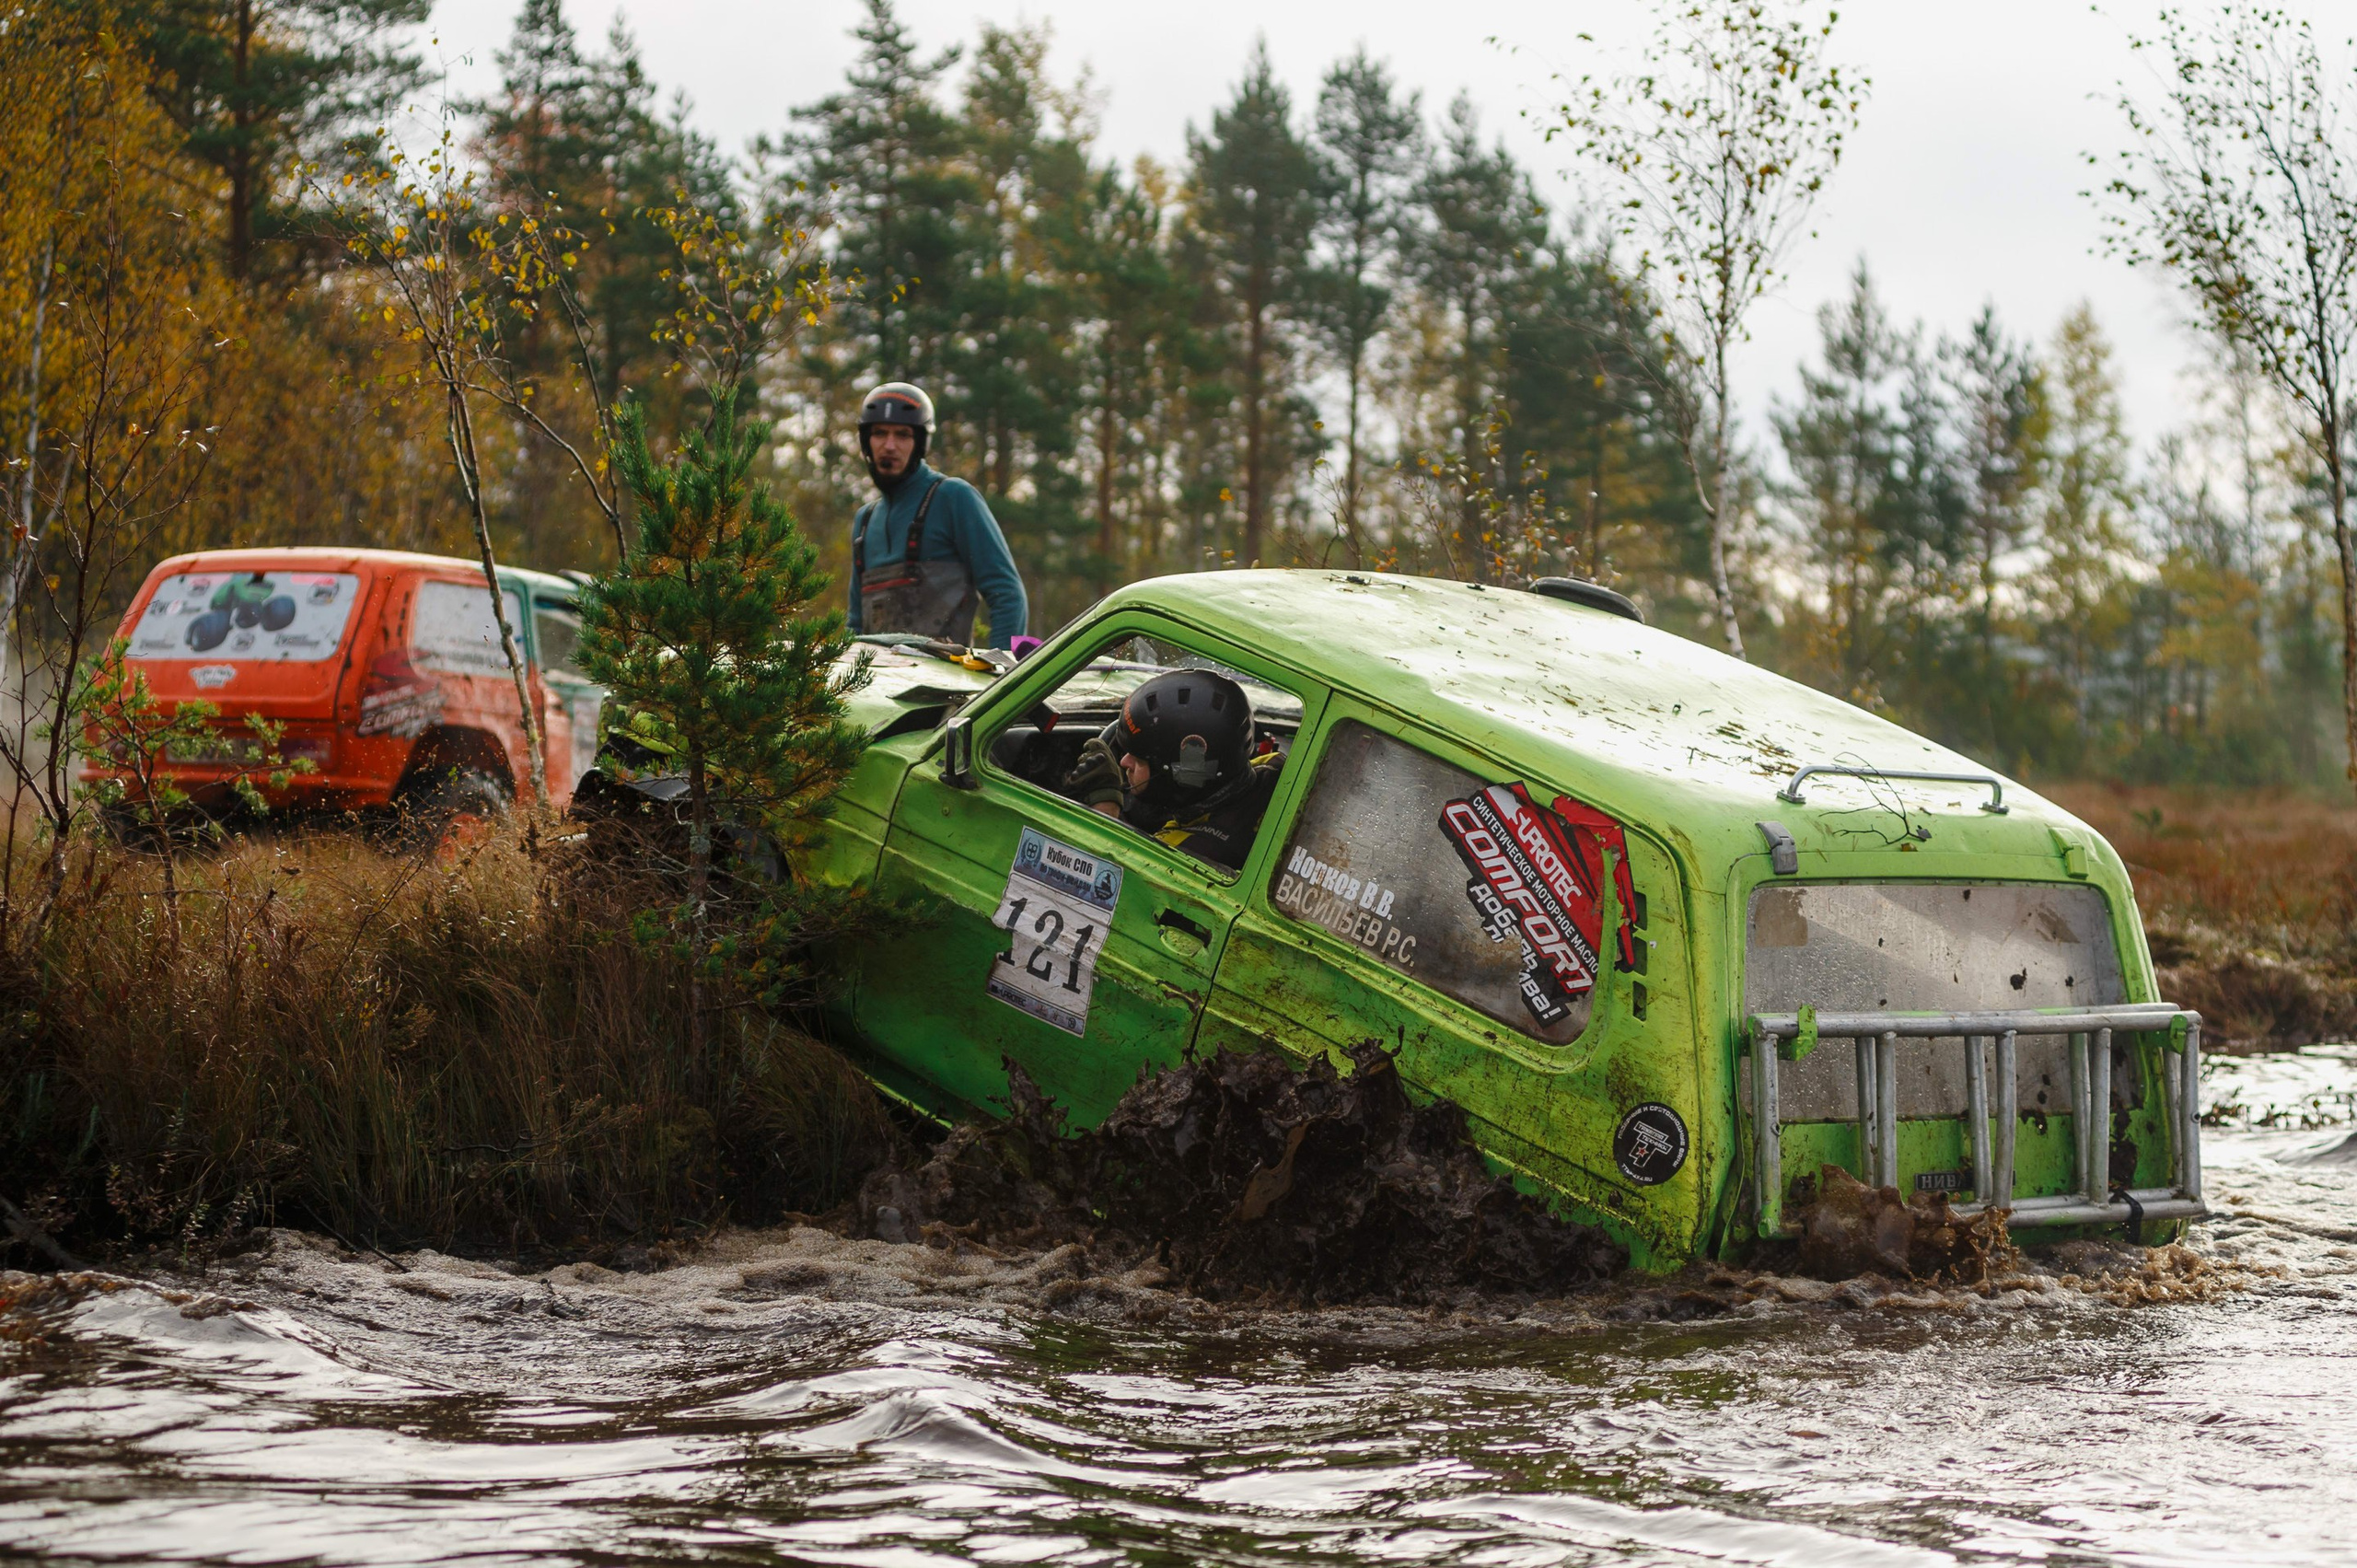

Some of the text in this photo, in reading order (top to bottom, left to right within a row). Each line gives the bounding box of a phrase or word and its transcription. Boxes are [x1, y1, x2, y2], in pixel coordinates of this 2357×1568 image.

[1047, 846, 1093, 877] Кубок СПб
[1473, 796, 1599, 974] СИНТЕТИЧЕСКОЕ МОТОРНОЕ МАСЛО
[1275, 874, 1417, 968] ВАСИЛЬЕВ Р.С.
[1359, 881, 1396, 921] В.В.
[998, 897, 1094, 994] 121
[1921, 1174, 1962, 1190] НИВ
